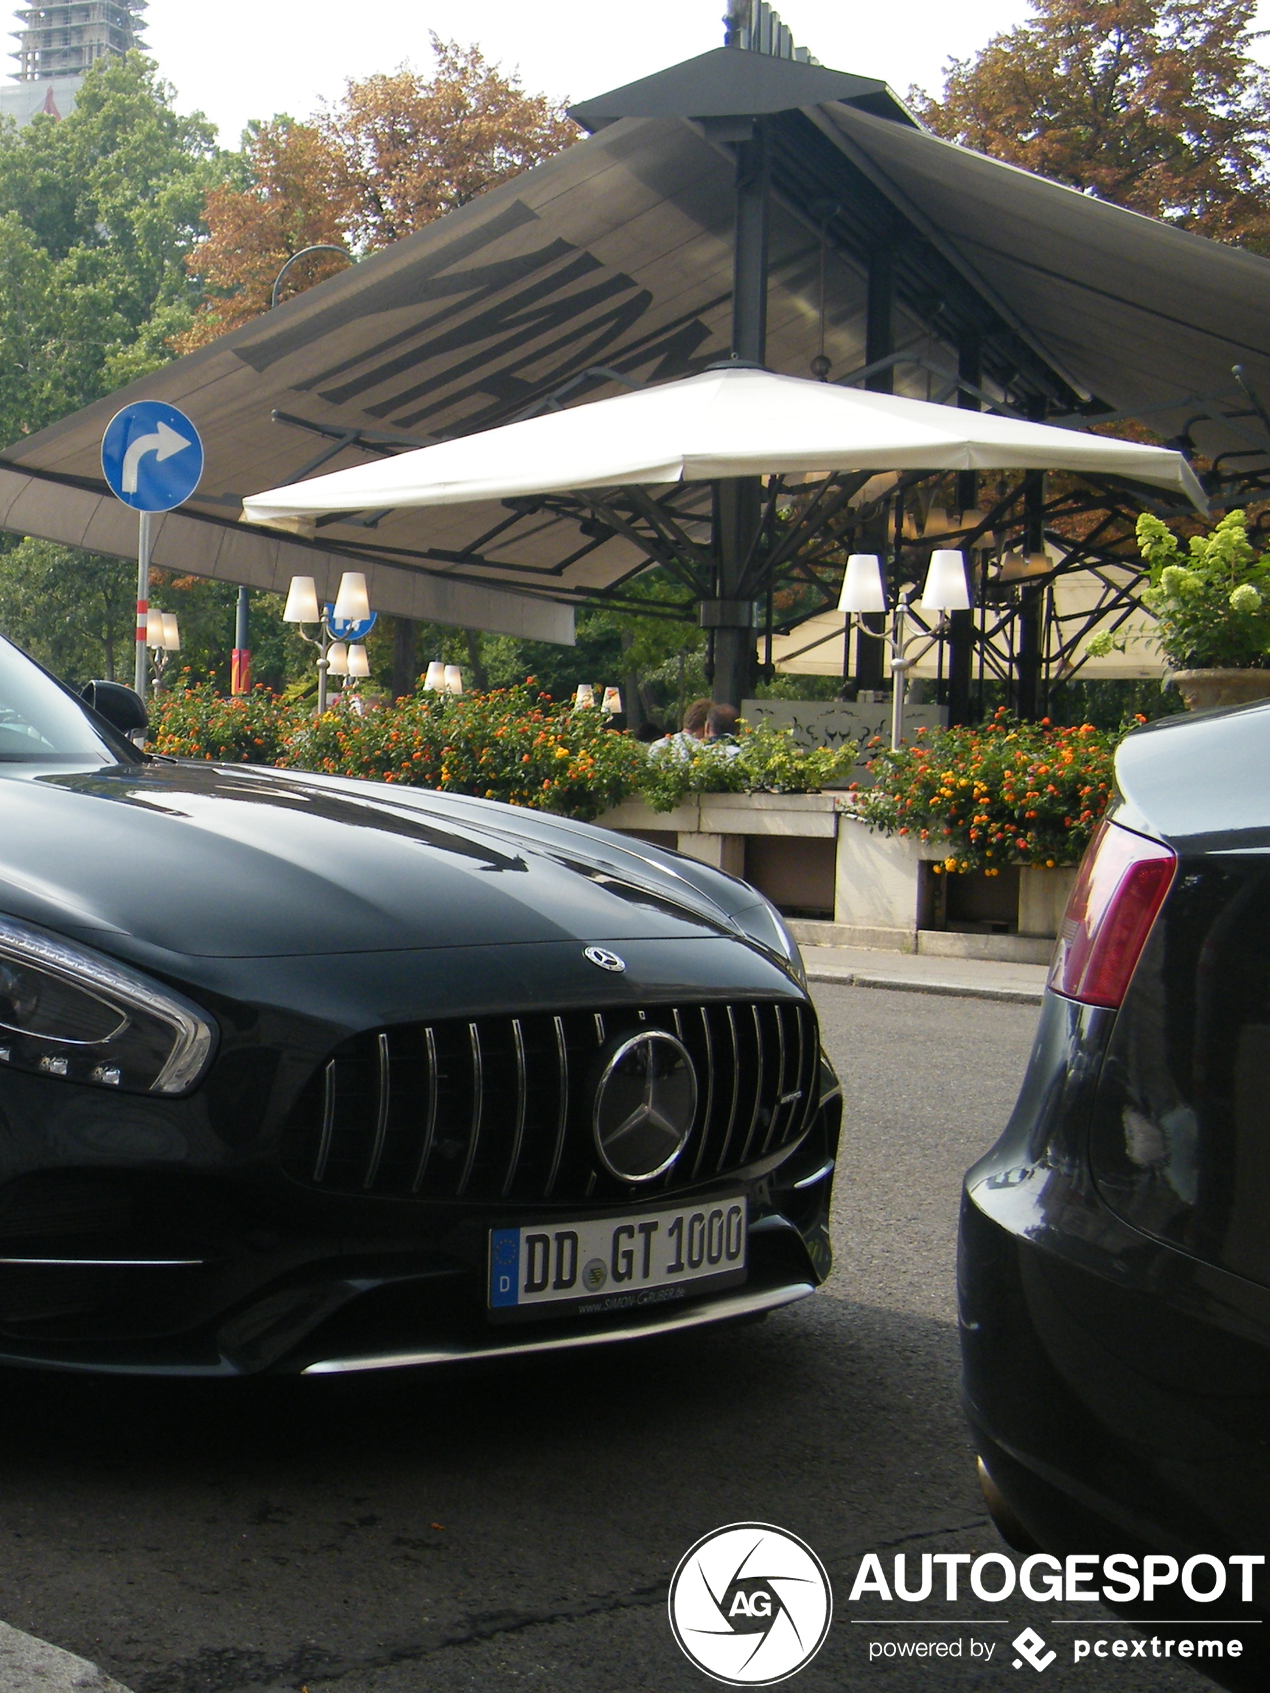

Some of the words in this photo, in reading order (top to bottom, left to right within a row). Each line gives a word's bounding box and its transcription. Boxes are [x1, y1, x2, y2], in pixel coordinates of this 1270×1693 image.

[524, 1231, 579, 1293] DD
[611, 1221, 659, 1283] GT
[667, 1204, 743, 1274] 1000
[499, 1276, 510, 1292] D
